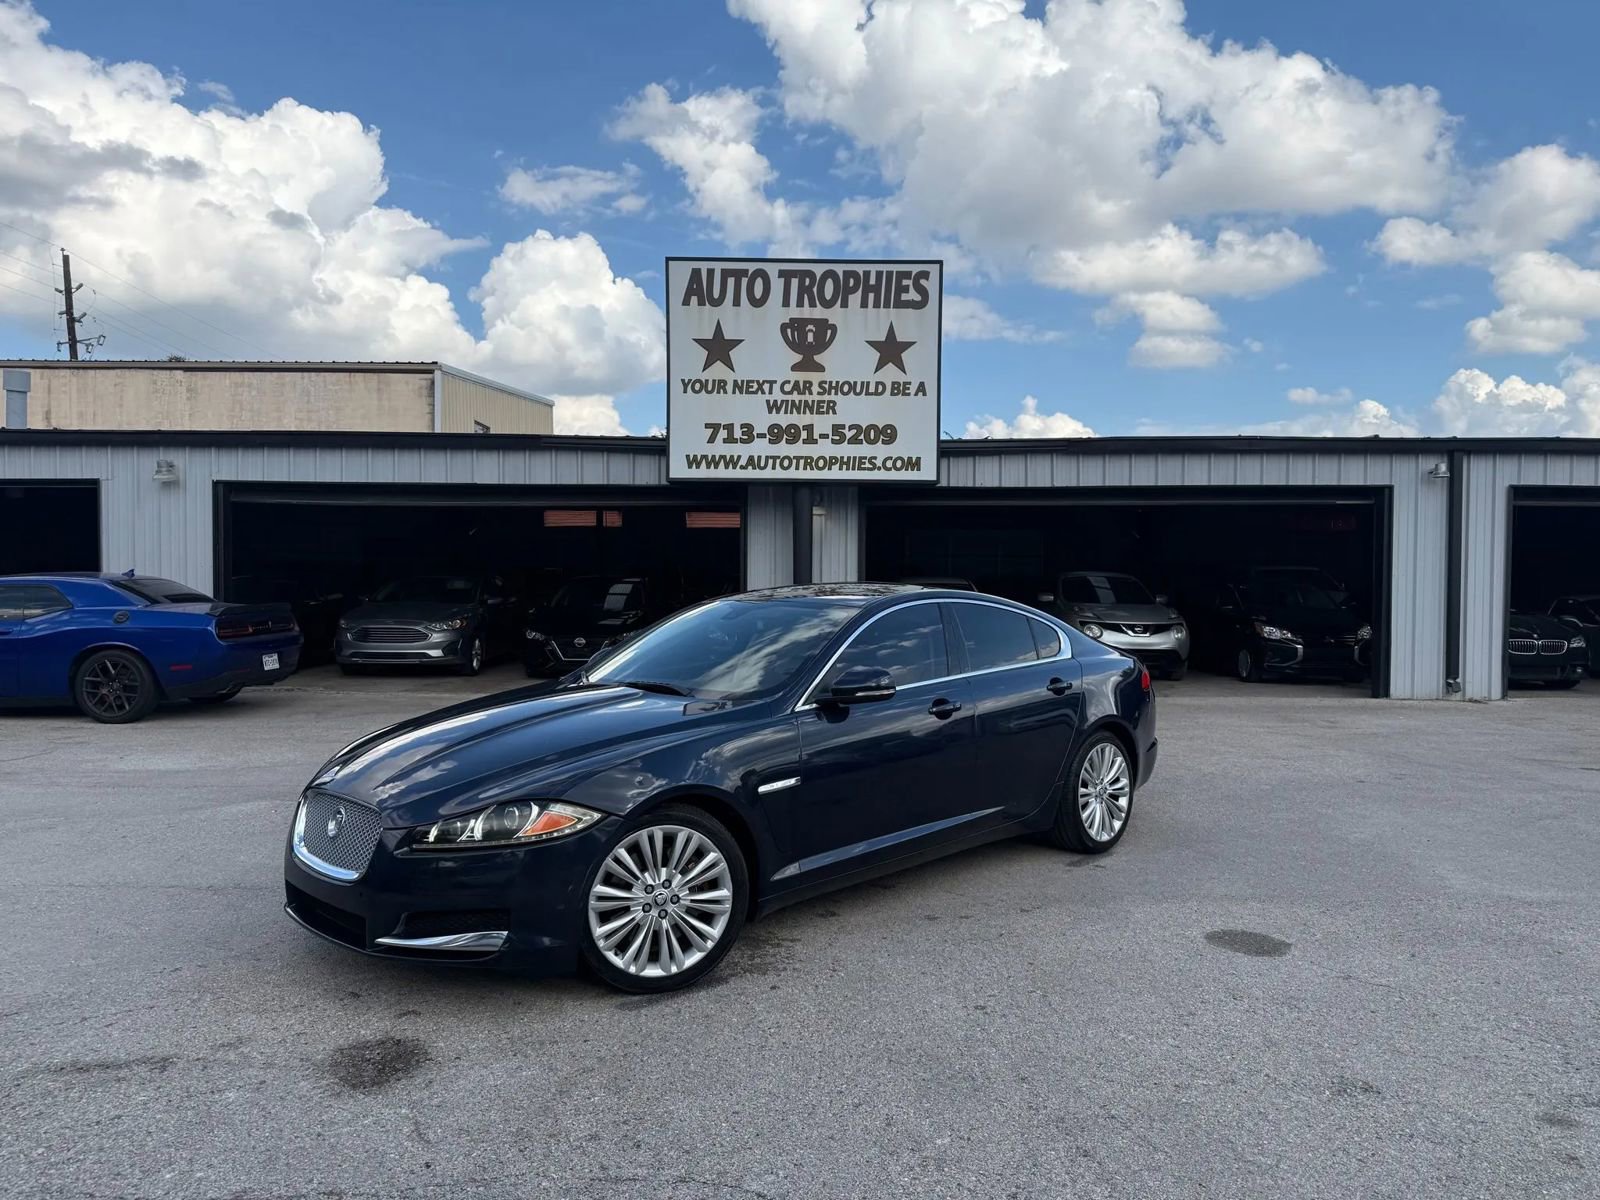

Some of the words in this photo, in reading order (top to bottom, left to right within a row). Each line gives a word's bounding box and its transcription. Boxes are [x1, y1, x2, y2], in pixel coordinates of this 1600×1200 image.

[682, 268, 771, 308] AUTO
[778, 269, 931, 310] TROPHIES
[681, 379, 728, 395] YOUR
[732, 380, 777, 395] NEXT
[780, 380, 813, 396] CAR
[817, 380, 886, 396] SHOULD
[890, 381, 912, 396] BE
[914, 381, 927, 396] A
[766, 399, 837, 415] WINNER
[705, 423, 898, 445] 713-991-5209
[685, 454, 921, 472] WWW.AUTOTROPHIES.COM
